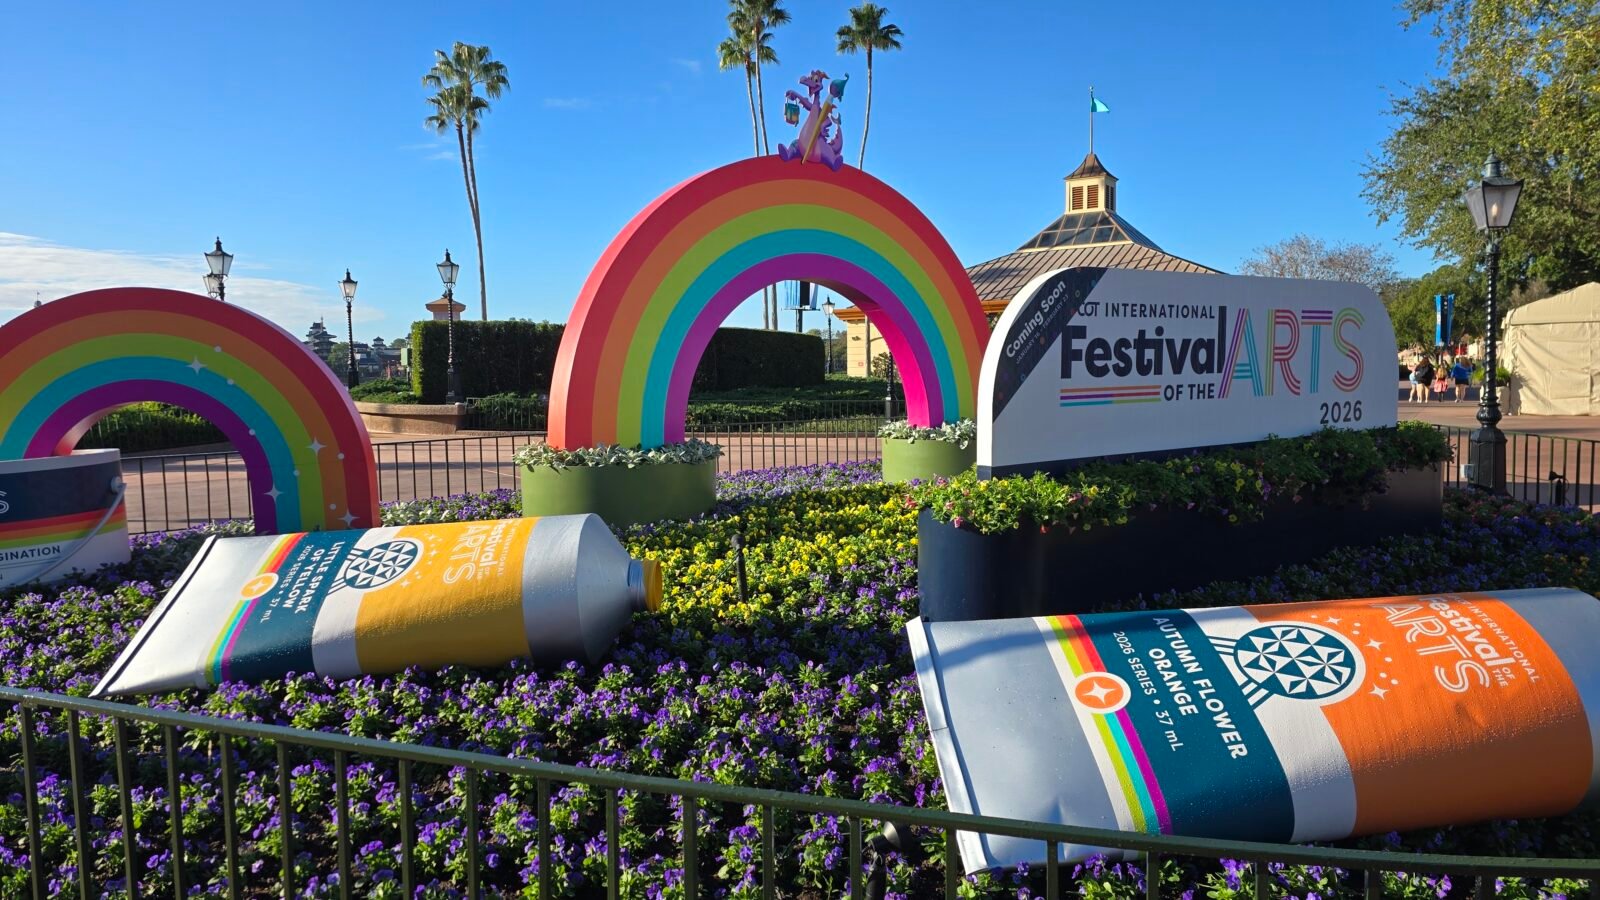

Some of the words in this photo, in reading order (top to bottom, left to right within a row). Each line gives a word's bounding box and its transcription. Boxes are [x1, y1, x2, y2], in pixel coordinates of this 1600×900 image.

[1006, 310, 1043, 358] Coming
[1041, 280, 1066, 312] Soon
[1078, 301, 1100, 317] COT
[1105, 302, 1215, 319] INTERNATIONAL
[1060, 305, 1227, 379] Festival
[1217, 306, 1365, 399] ARTS
[1163, 384, 1183, 401] OF
[1188, 382, 1215, 400] THE
[1319, 400, 1362, 425] 2026
[297, 544, 315, 561] 2026
[310, 548, 326, 562] OF
[316, 541, 346, 574] LITTLE
[442, 525, 491, 584] ARTS
[280, 562, 302, 588] SERIES
[282, 563, 317, 608] YELLOW
[269, 597, 281, 607] 37
[294, 575, 324, 614] SPARK
[1113, 631, 1136, 655] 2026
[1371, 603, 1490, 693] ARTS
[1467, 605, 1541, 683] INTERNATIONAL
[1127, 657, 1157, 696] SERIES
[1148, 648, 1199, 716] ORANGE
[1492, 668, 1509, 688] THE
[1501, 666, 1516, 680] OF
[1152, 617, 1203, 674] AUTUMN
[1193, 678, 1248, 759] FLOWER
[1155, 710, 1174, 726] 37
[1164, 729, 1184, 752] mL
